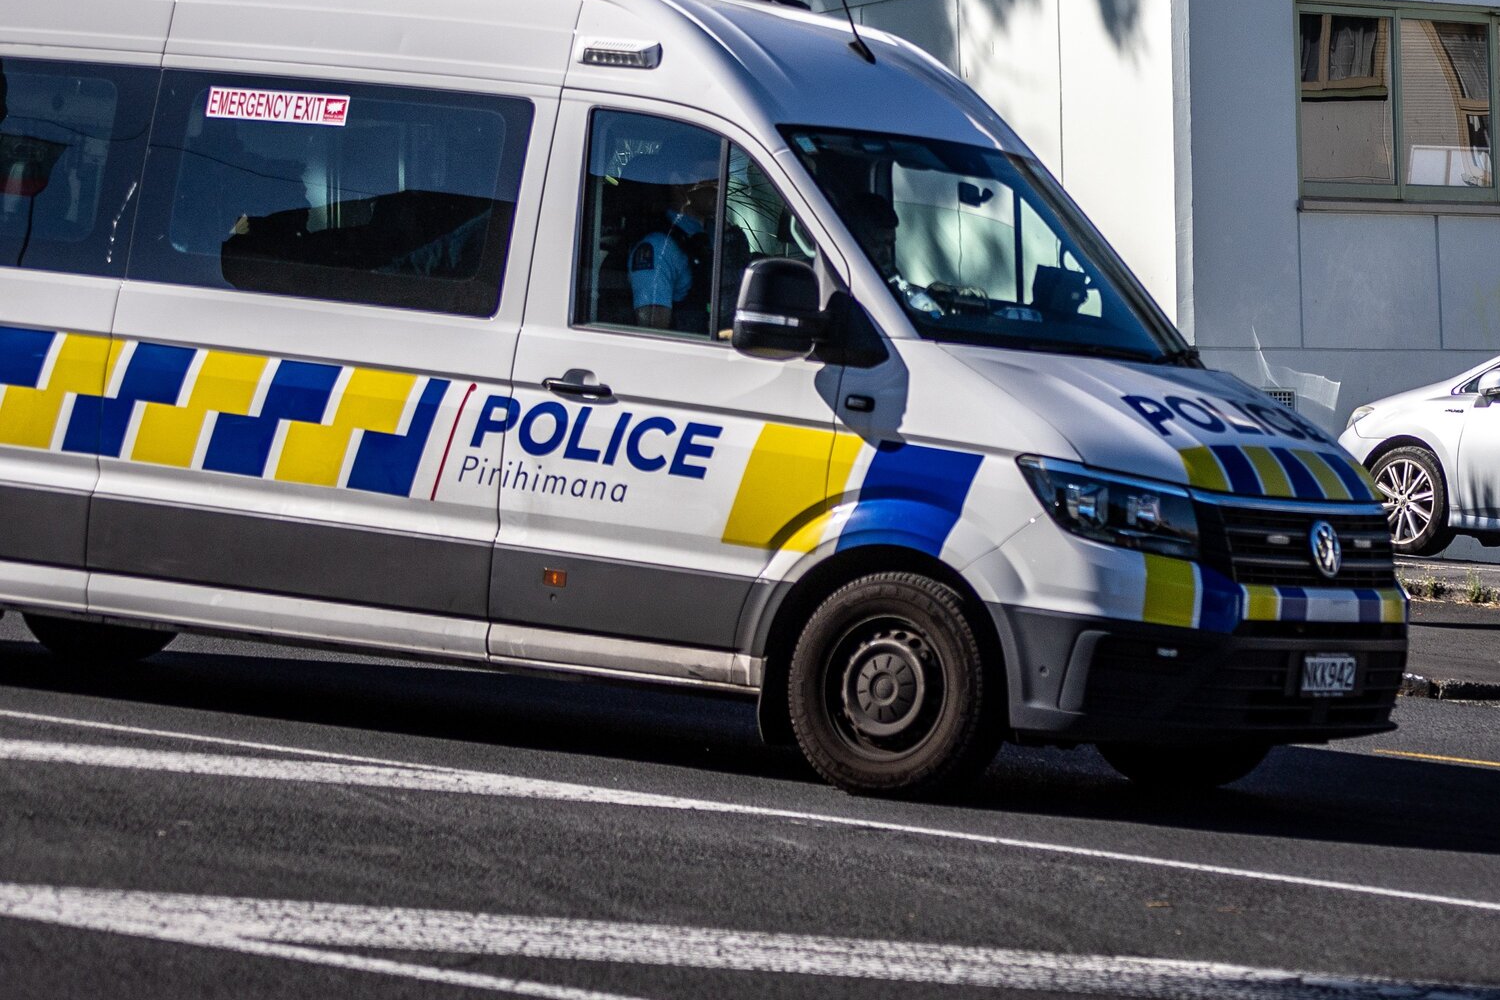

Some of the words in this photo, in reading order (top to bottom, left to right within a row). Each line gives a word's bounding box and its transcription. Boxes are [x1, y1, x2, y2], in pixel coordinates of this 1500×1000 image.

[209, 90, 293, 119] EMERGENCY
[293, 96, 325, 122] EXIT
[470, 394, 724, 480] POLICE
[1120, 394, 1335, 446] POLICE
[458, 455, 629, 504] Pirihimana
[1303, 661, 1354, 689] NKK942
